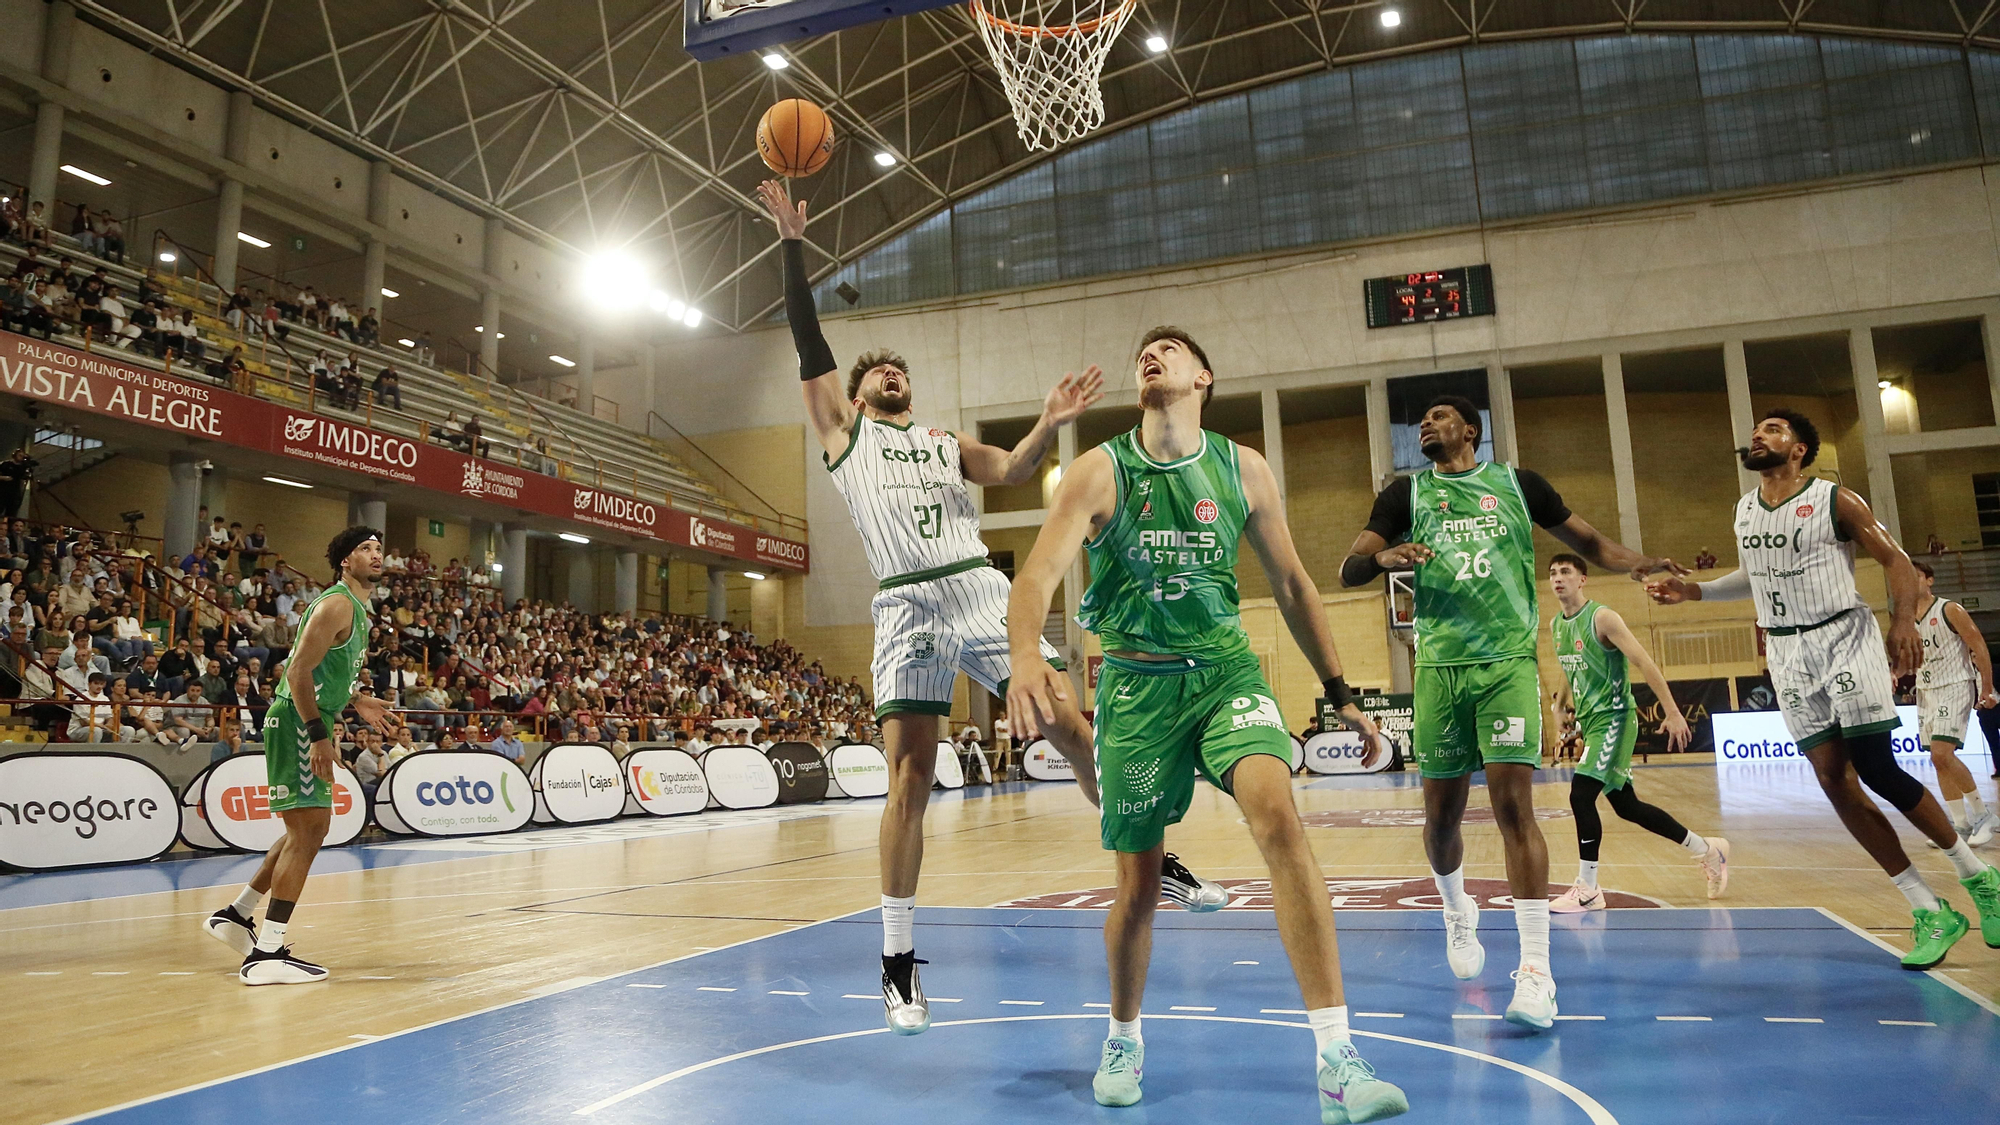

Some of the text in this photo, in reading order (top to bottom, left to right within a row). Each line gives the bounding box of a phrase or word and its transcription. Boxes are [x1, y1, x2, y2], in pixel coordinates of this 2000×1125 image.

[1401, 295, 1416, 306] 44
[18, 342, 209, 402] PALACIO MUNICIPAL DEPORTES
[0, 356, 223, 436] VISTA ALEGRE
[318, 420, 418, 468] IMDECO
[284, 444, 314, 459] Instituto
[315, 452, 348, 466] Municipal
[349, 460, 359, 469] de
[359, 462, 389, 476] Deportes
[882, 447, 932, 464] coto
[594, 492, 656, 526] IMDECO
[914, 503, 943, 539] 27
[1442, 514, 1499, 532] AMICS
[1139, 530, 1216, 549] AMICS
[1435, 523, 1509, 544] CASTELLÓ
[1742, 531, 1788, 549] coto
[768, 539, 805, 561] IMDECO
[1128, 546, 1224, 566] CASTELLÓ
[1454, 548, 1492, 581] 26
[1771, 567, 1805, 579] Cajasol
[1766, 591, 1787, 617] 15
[1573, 677, 1581, 698] 4
[263, 716, 280, 728] xa
[1374, 708, 1413, 718] ORGULLO
[1391, 730, 1409, 740] CHA
[797, 759, 822, 772] nogomet
[548, 773, 620, 792] Fundación Cajasol
[659, 771, 700, 783] Diputación
[416, 775, 495, 807] coto
[664, 783, 704, 795] de Córdoba
[0, 795, 158, 839] neogare
[421, 814, 500, 828] Contigo, con todo.
